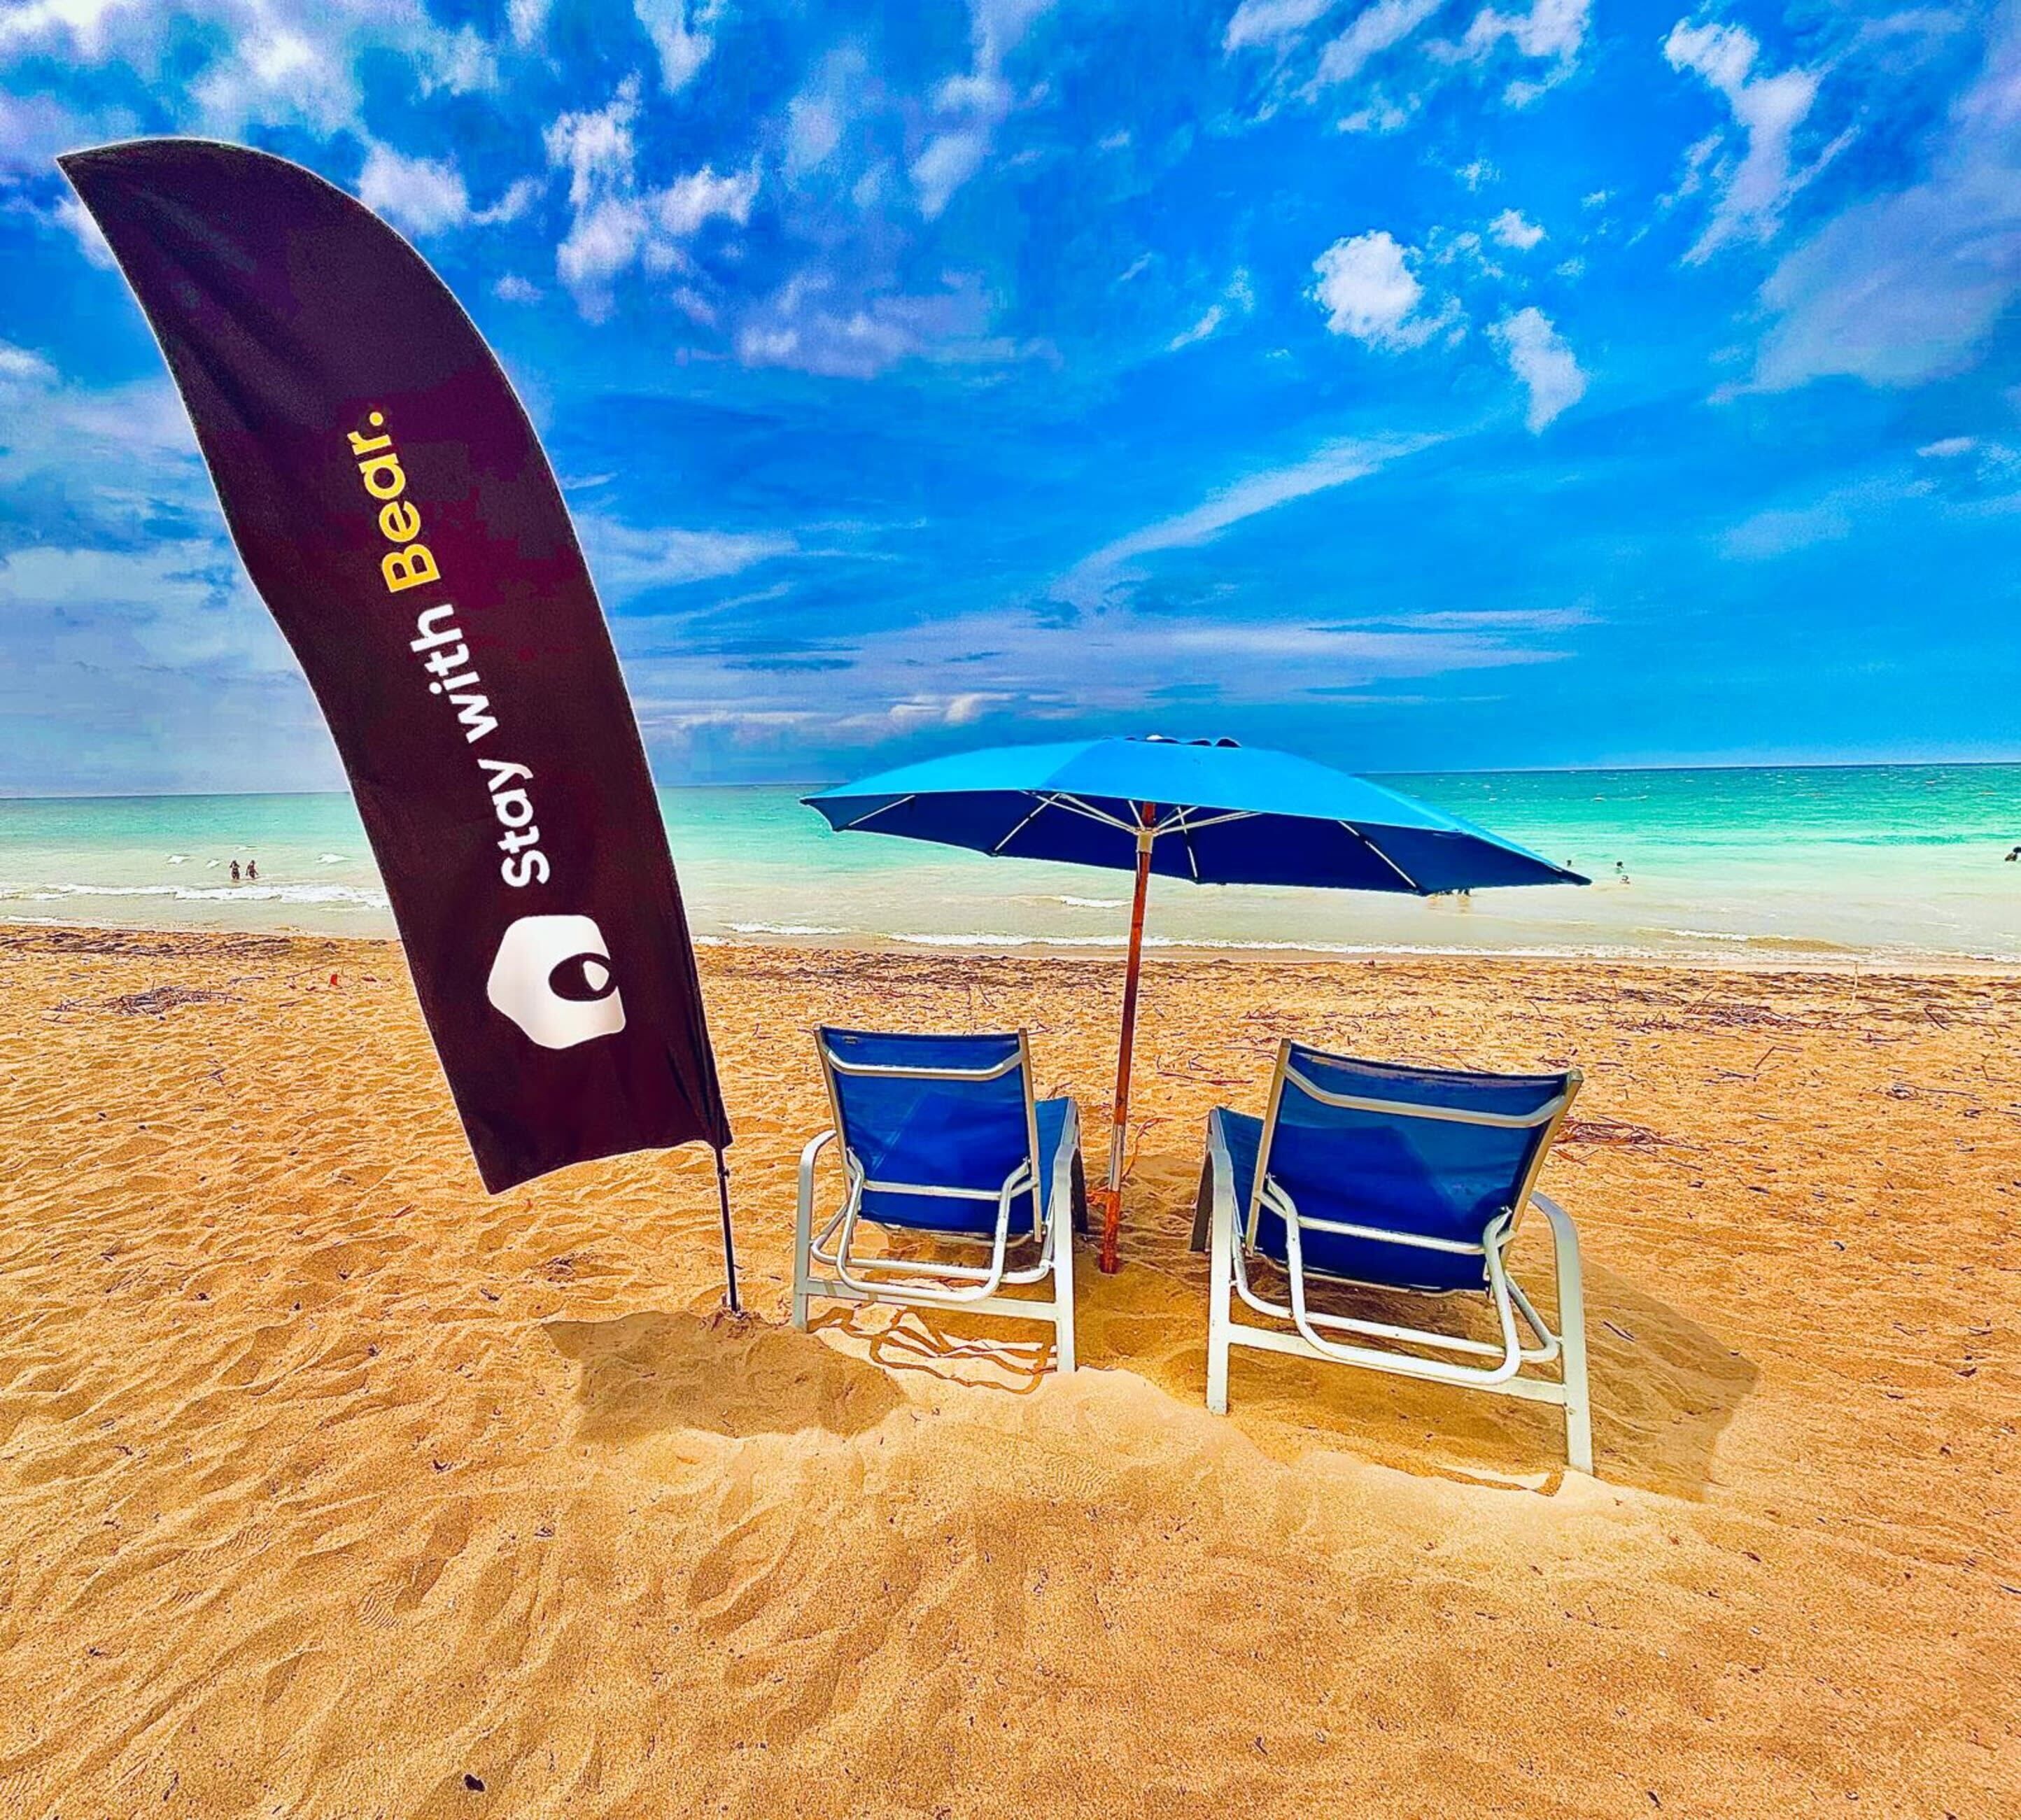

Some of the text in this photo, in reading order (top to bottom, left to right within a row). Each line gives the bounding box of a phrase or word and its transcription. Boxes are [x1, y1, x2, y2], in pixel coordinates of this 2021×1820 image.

[346, 411, 550, 887] Stay with Bear.
